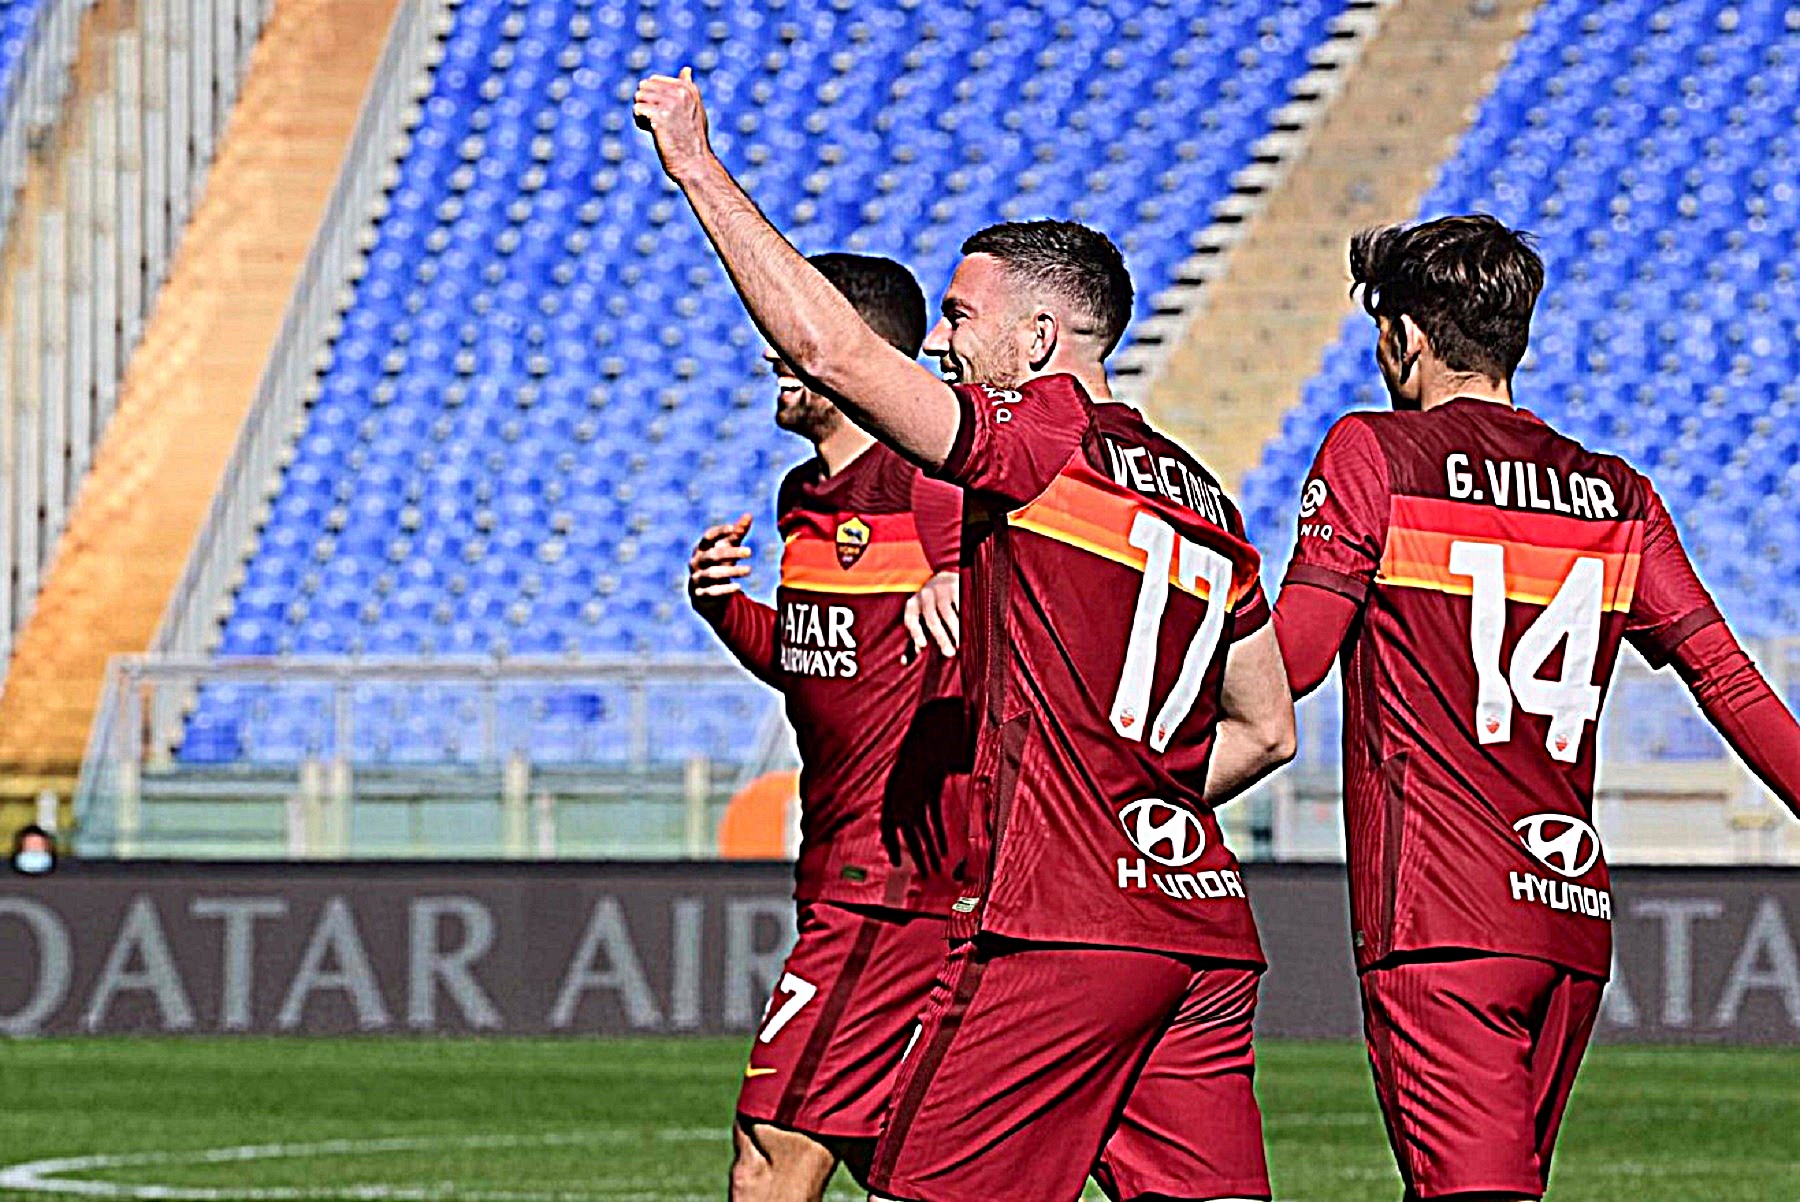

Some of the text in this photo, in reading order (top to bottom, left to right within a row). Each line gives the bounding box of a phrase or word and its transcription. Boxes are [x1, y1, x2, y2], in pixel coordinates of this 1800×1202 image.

[1104, 437, 1229, 533] VEETOUT
[1446, 453, 1618, 519] G.VILLAR
[780, 602, 857, 649] ATAR
[1109, 511, 1233, 752] 17
[1449, 540, 1604, 763] 14
